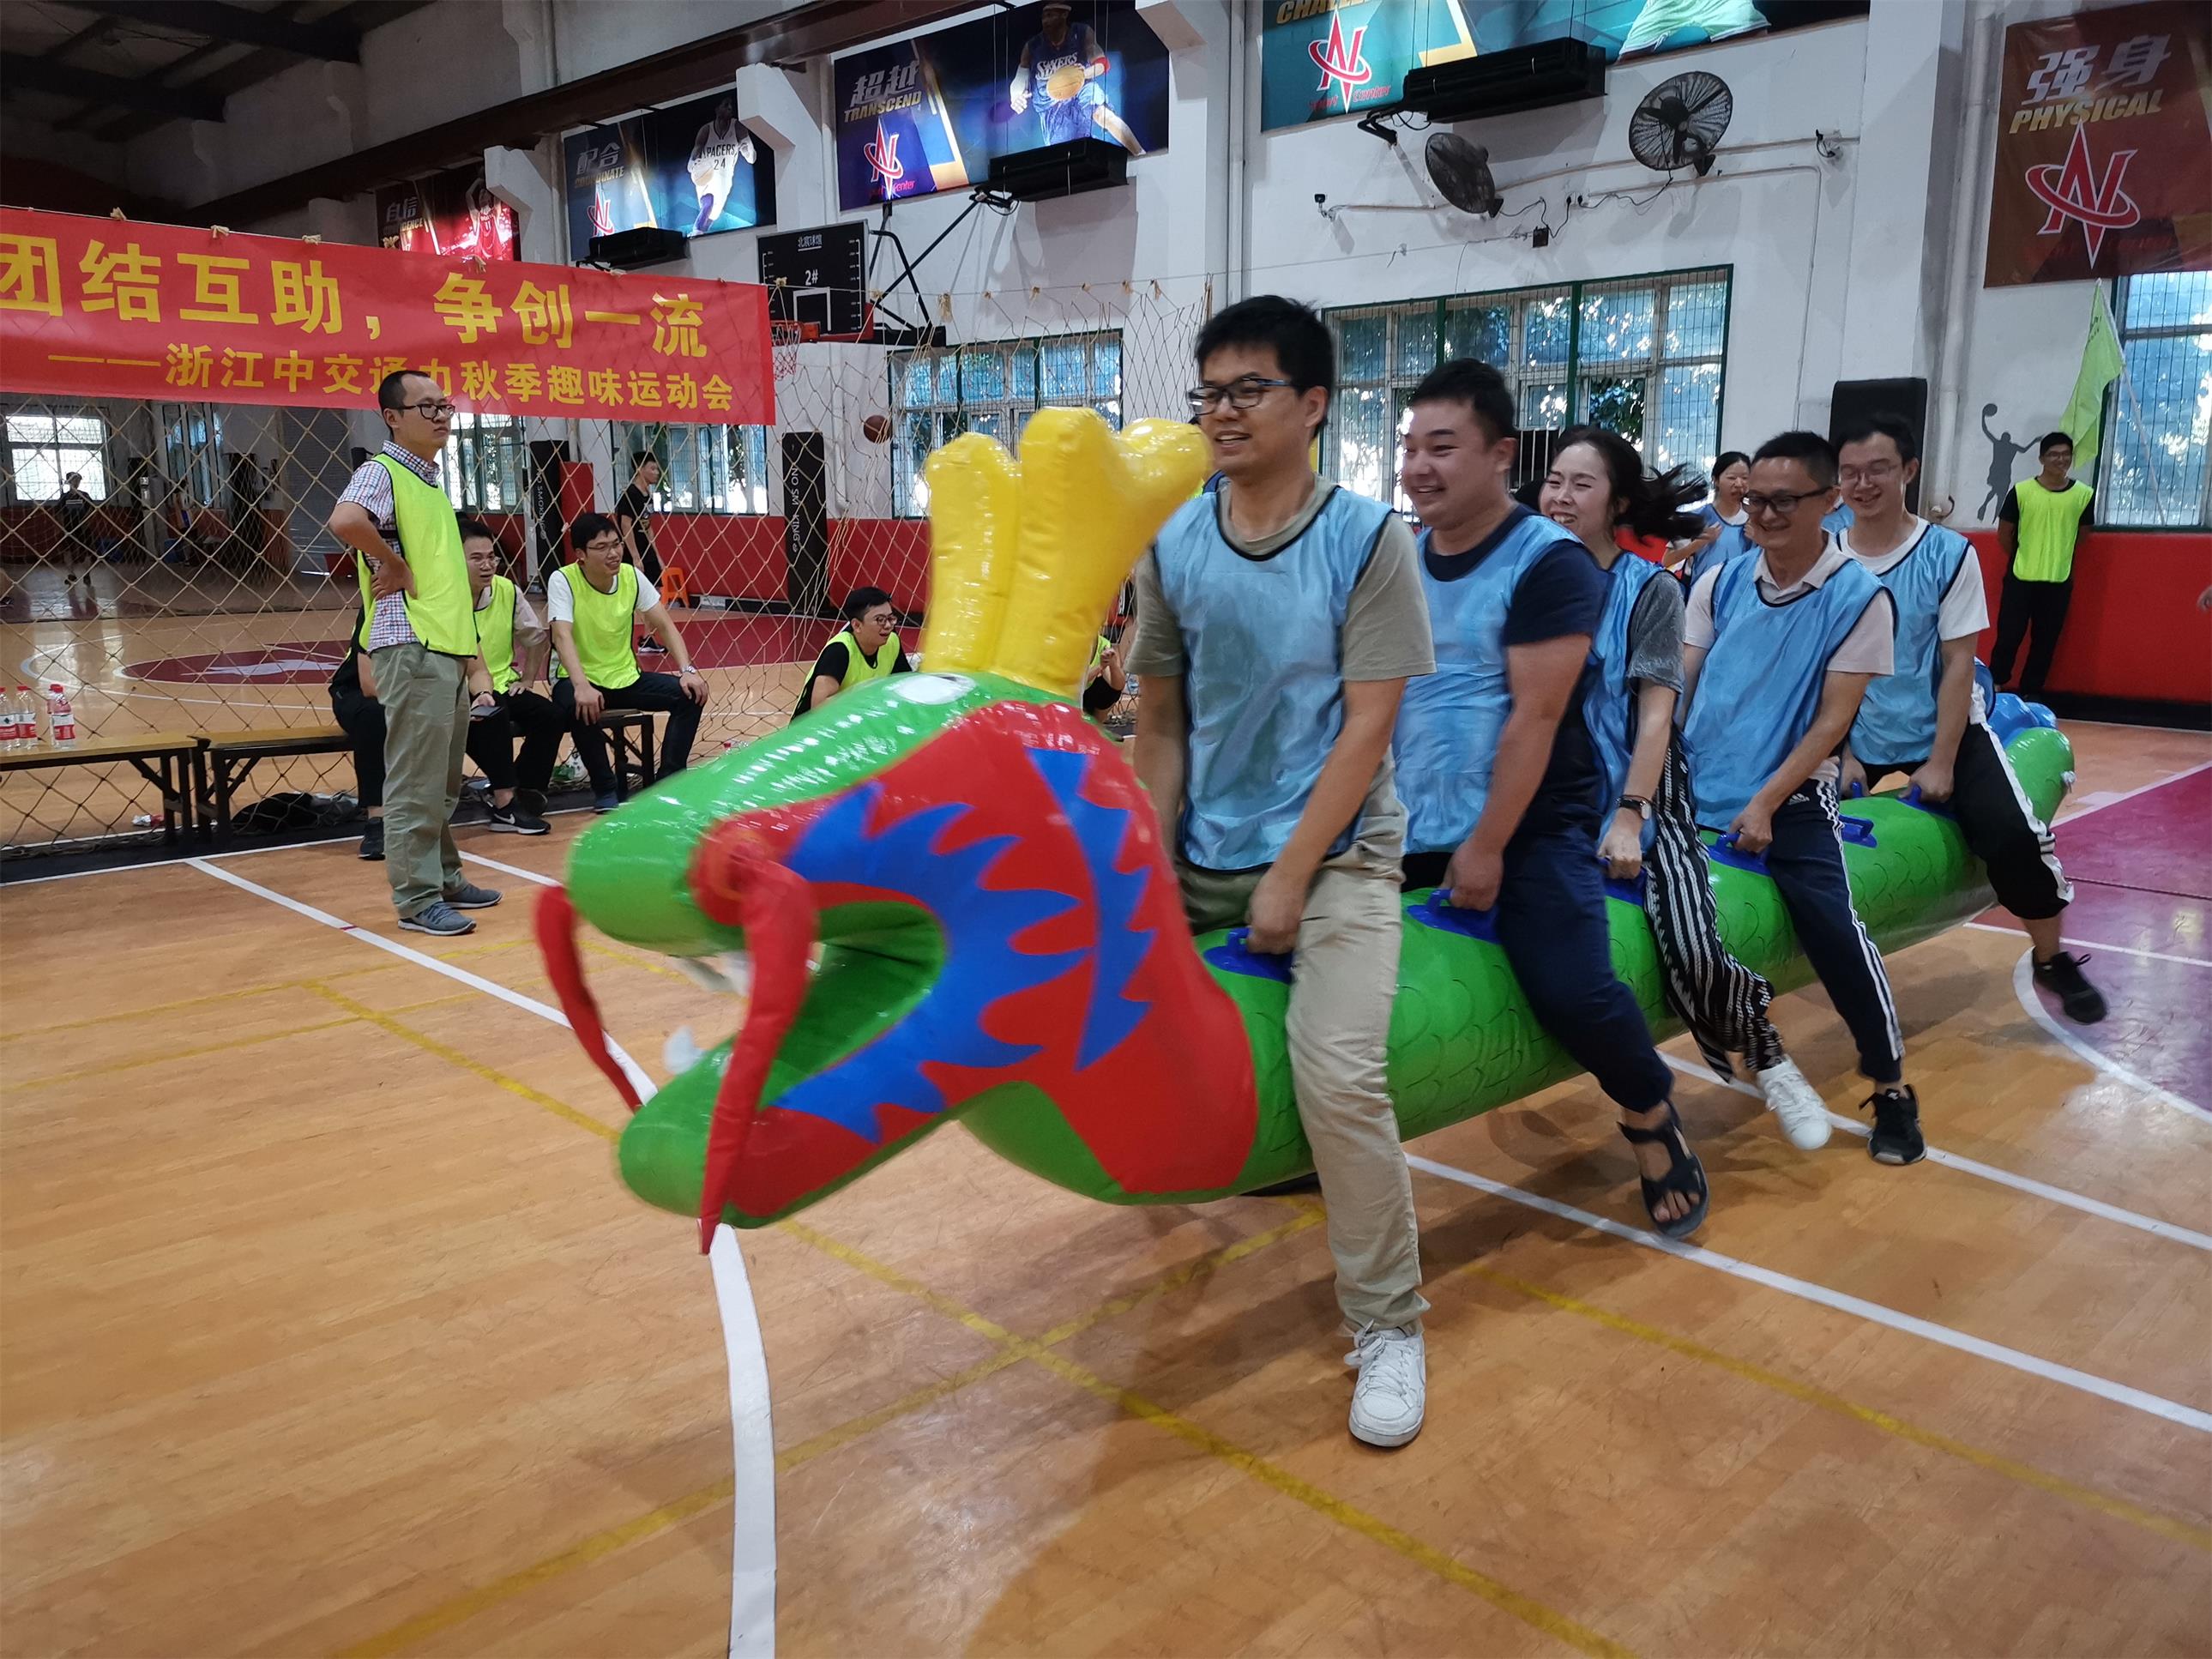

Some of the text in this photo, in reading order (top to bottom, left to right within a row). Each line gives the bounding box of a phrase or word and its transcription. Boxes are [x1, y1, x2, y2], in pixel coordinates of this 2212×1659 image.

[849, 60, 920, 108] 超越
[2022, 33, 2172, 106] 强身
[844, 91, 922, 124] TRANSCEND
[2009, 89, 2162, 134] PHYSICAL
[576, 142, 620, 175] 配合
[707, 143, 736, 158] PACERS
[714, 158, 726, 171] 24
[386, 196, 418, 223] 自信
[805, 268, 818, 286] 2#
[792, 467, 800, 541] NO SMKING
